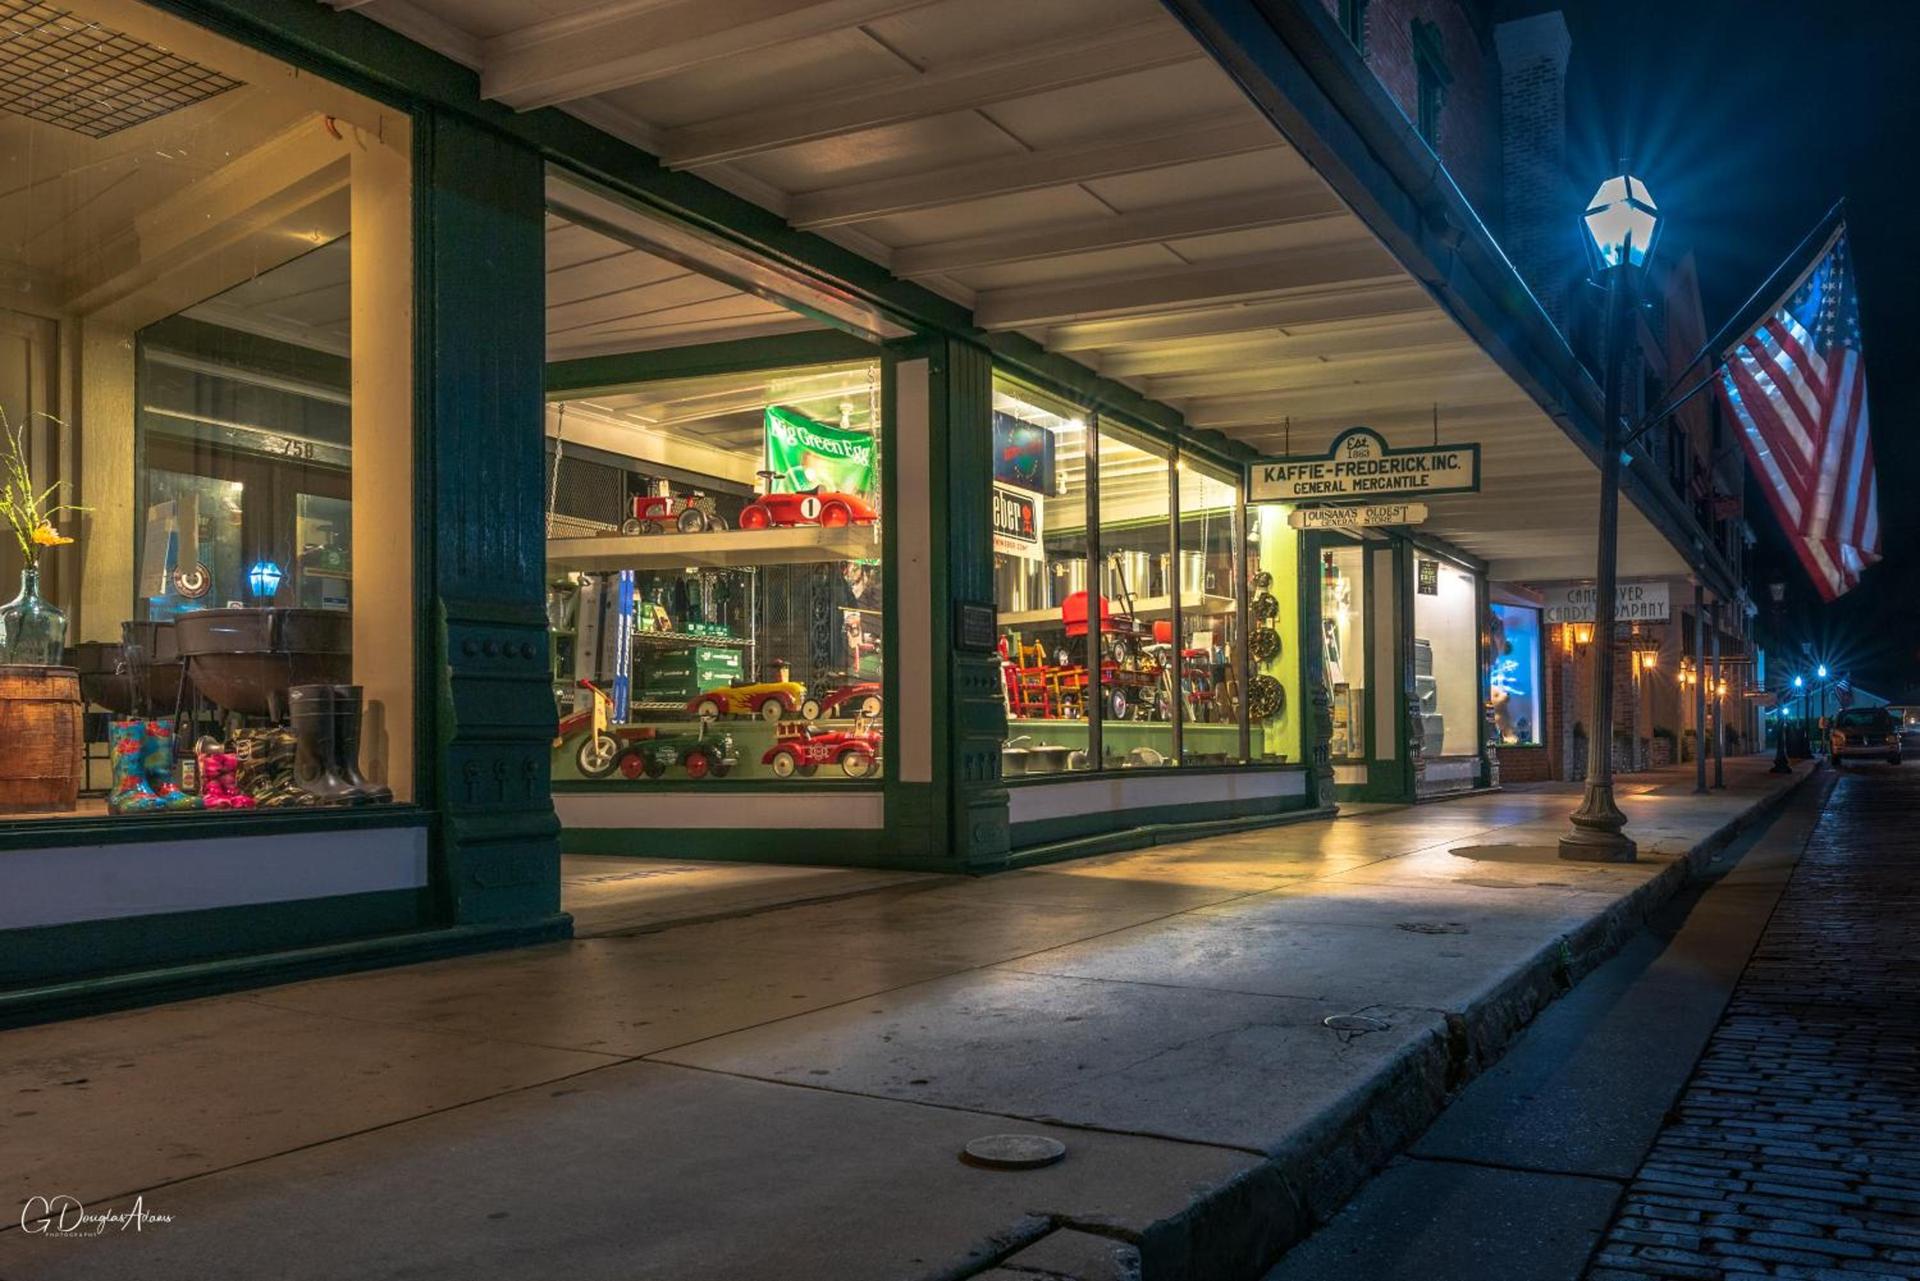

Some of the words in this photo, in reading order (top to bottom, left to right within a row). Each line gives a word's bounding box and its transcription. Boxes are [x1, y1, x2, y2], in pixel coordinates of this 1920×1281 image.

[797, 426, 843, 455] Green
[1293, 480, 1347, 495] GENERAL
[1352, 474, 1430, 491] MERCANTILE
[808, 498, 814, 517] 1
[993, 490, 1021, 532] eber
[1366, 505, 1408, 522] OLDEST
[1547, 606, 1589, 621] CANDY
[1613, 602, 1665, 618] OMPANY
